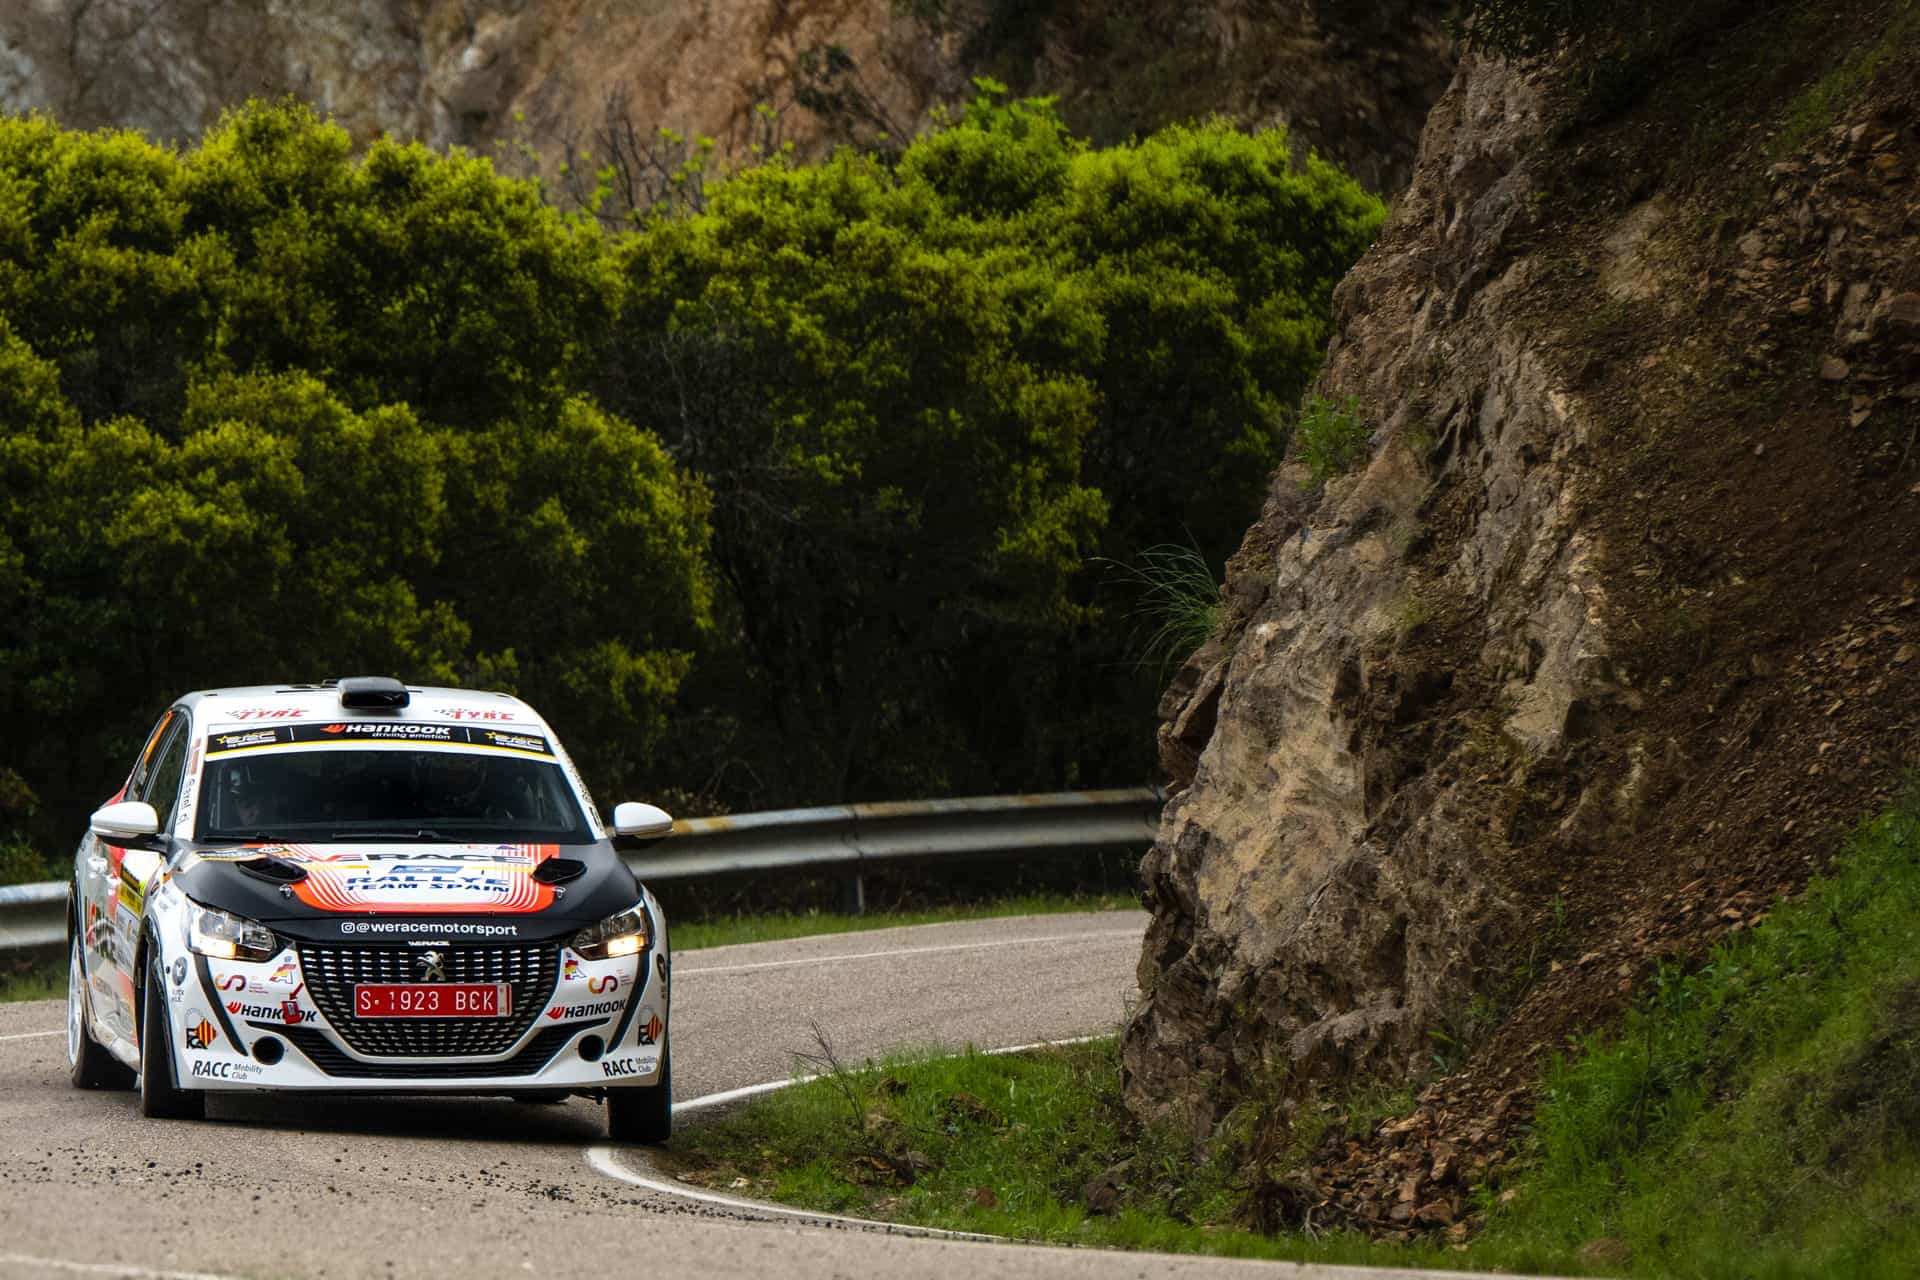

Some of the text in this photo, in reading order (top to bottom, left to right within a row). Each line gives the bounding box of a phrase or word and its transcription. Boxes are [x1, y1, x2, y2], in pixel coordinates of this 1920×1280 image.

[344, 883, 510, 893] TEAM SPAIN
[346, 876, 510, 886] RALLYE
[389, 991, 440, 1010] 1923
[192, 1060, 264, 1078] RACC Mobility
[602, 1058, 637, 1077] RACC
[231, 1072, 249, 1080] Club
